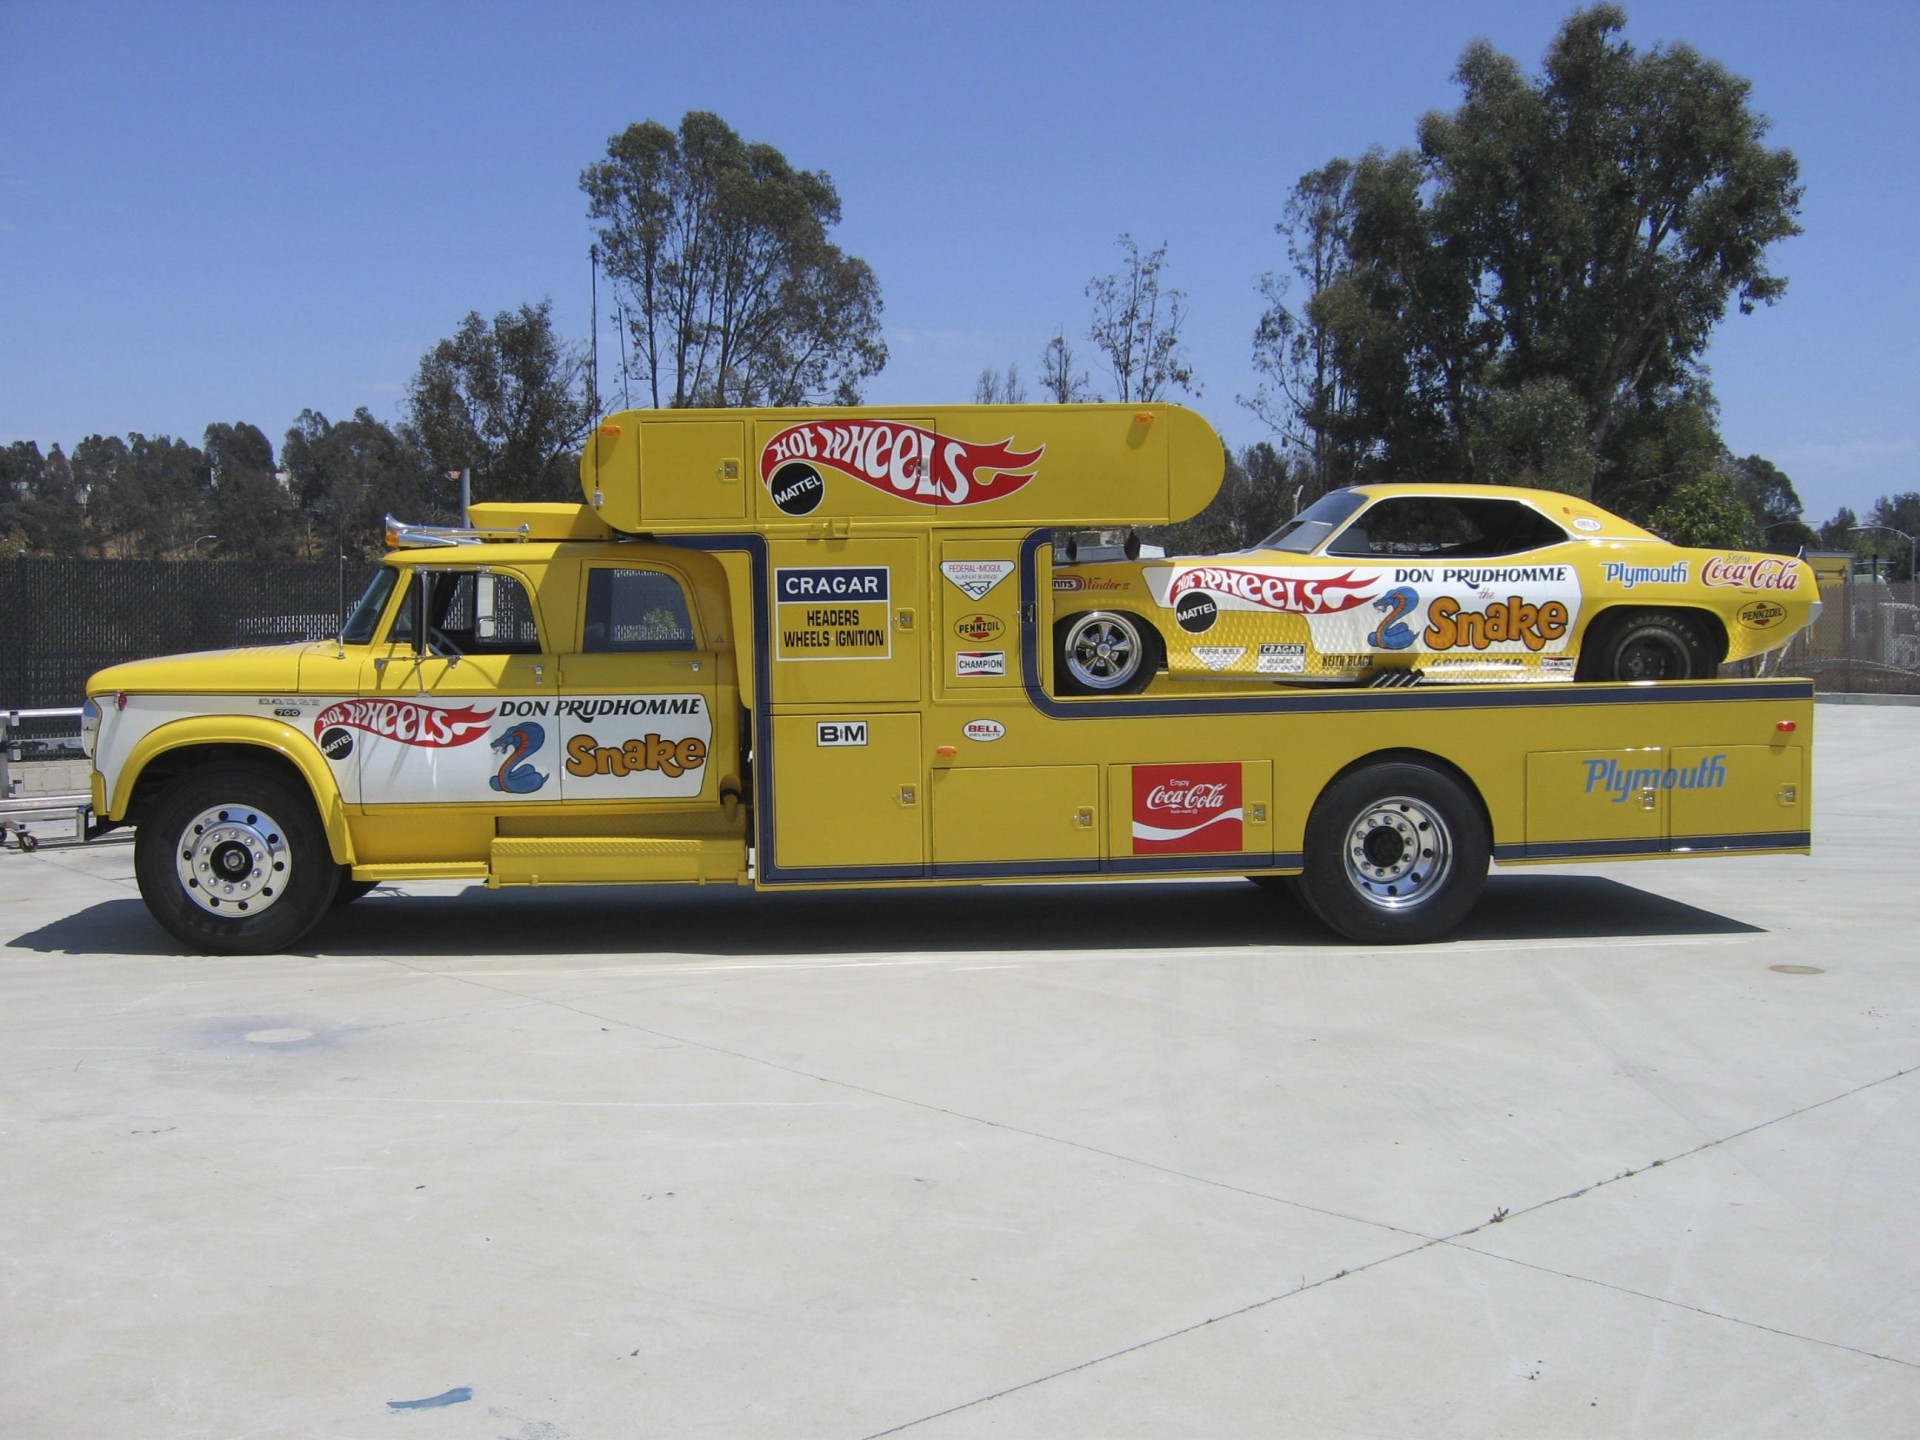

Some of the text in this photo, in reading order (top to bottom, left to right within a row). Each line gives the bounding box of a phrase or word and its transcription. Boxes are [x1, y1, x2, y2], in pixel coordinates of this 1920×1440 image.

[774, 476, 821, 505] MATTEL
[949, 564, 1003, 573] FEDERAL-MOGUL
[1601, 562, 1687, 588] Plymouth
[785, 576, 878, 595] CRAGAR
[1395, 567, 1566, 590] DON PRUDHOMME
[1478, 588, 1495, 600] the
[807, 610, 859, 627] HEADERS
[1177, 603, 1216, 622] MATTEL
[1742, 608, 1783, 621] PENNZOIL
[959, 621, 1000, 634] PENNZOIL
[1423, 595, 1568, 651] Snake
[784, 630, 884, 648] WHEELS IGNITION
[1263, 645, 1302, 654] CRAGAR
[959, 659, 1002, 670] CHAMPION
[1347, 655, 1374, 666] BLACK
[499, 699, 701, 723] DON PRUDHOMME
[968, 725, 1000, 733] BELL
[322, 733, 354, 755] MATTEL
[565, 733, 707, 778] Snake
[1170, 779, 1190, 787] Enjoy
[1583, 754, 1727, 803] Plymouth
